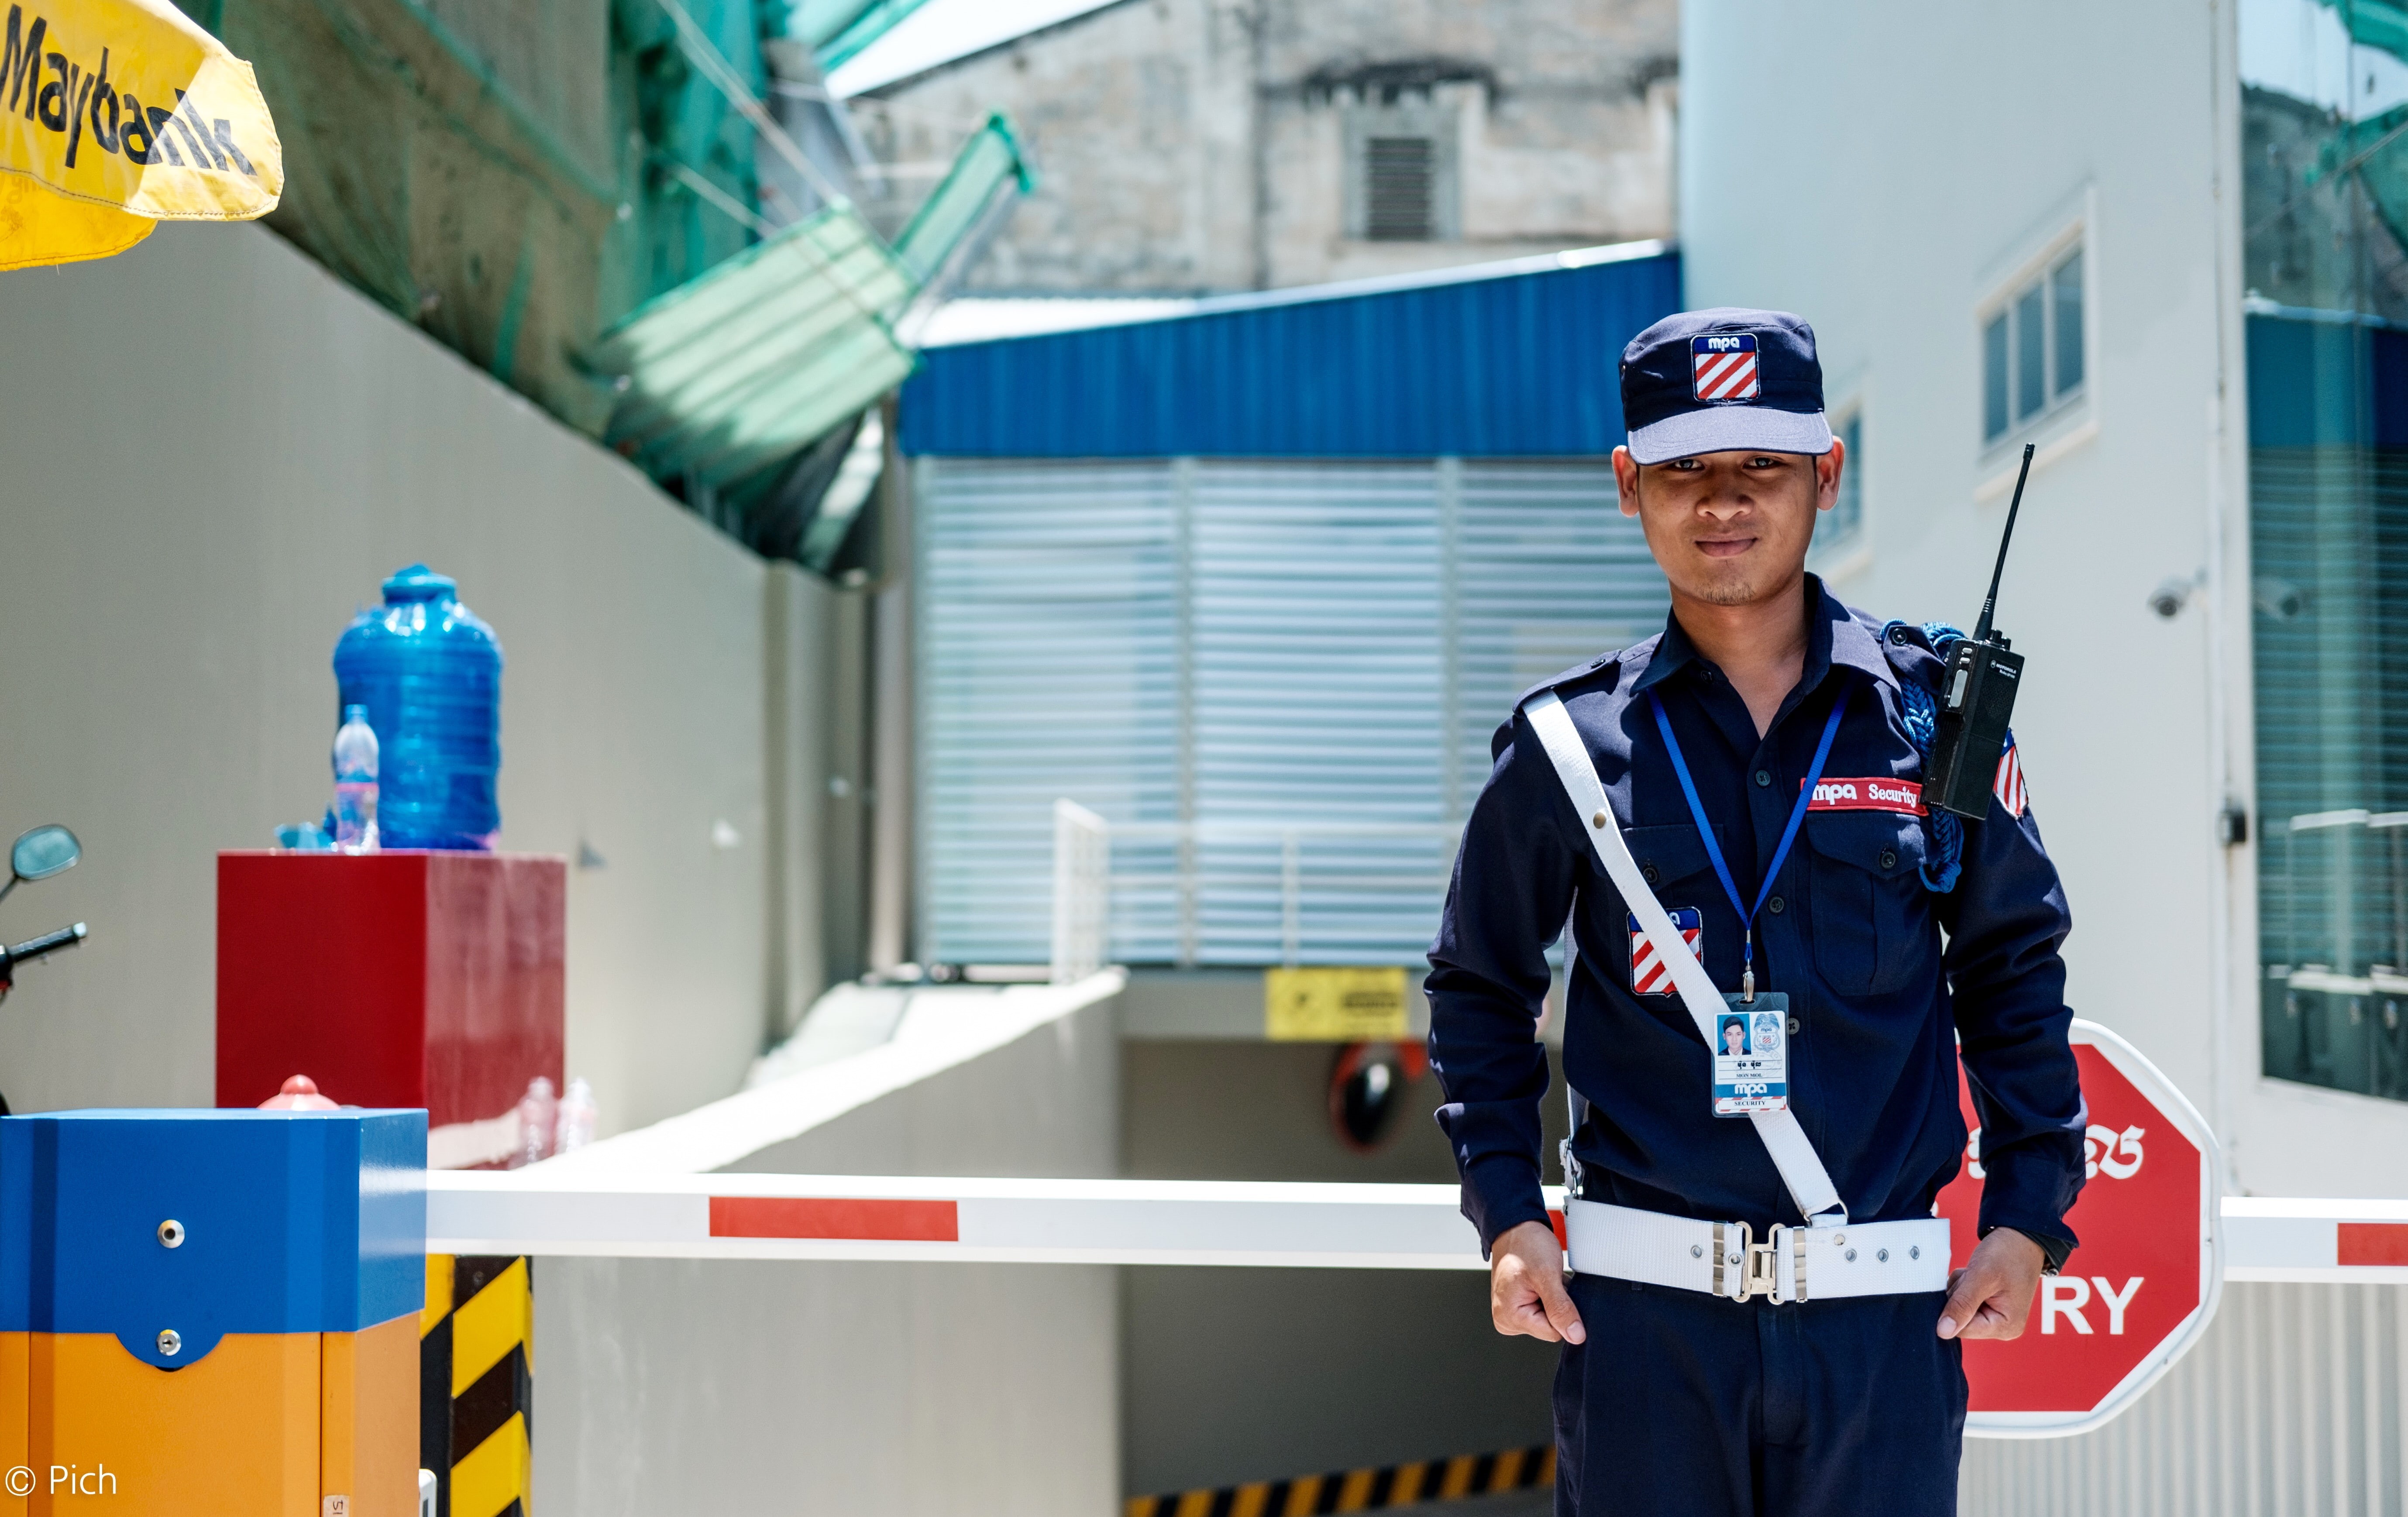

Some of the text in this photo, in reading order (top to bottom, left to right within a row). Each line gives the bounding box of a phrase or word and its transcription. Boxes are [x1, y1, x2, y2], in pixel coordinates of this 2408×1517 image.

[0, 3, 258, 176] Maybank
[1708, 337, 1740, 352] mpa
[1812, 784, 1917, 808] mpa Security
[1734, 1084, 1768, 1097] mpa
